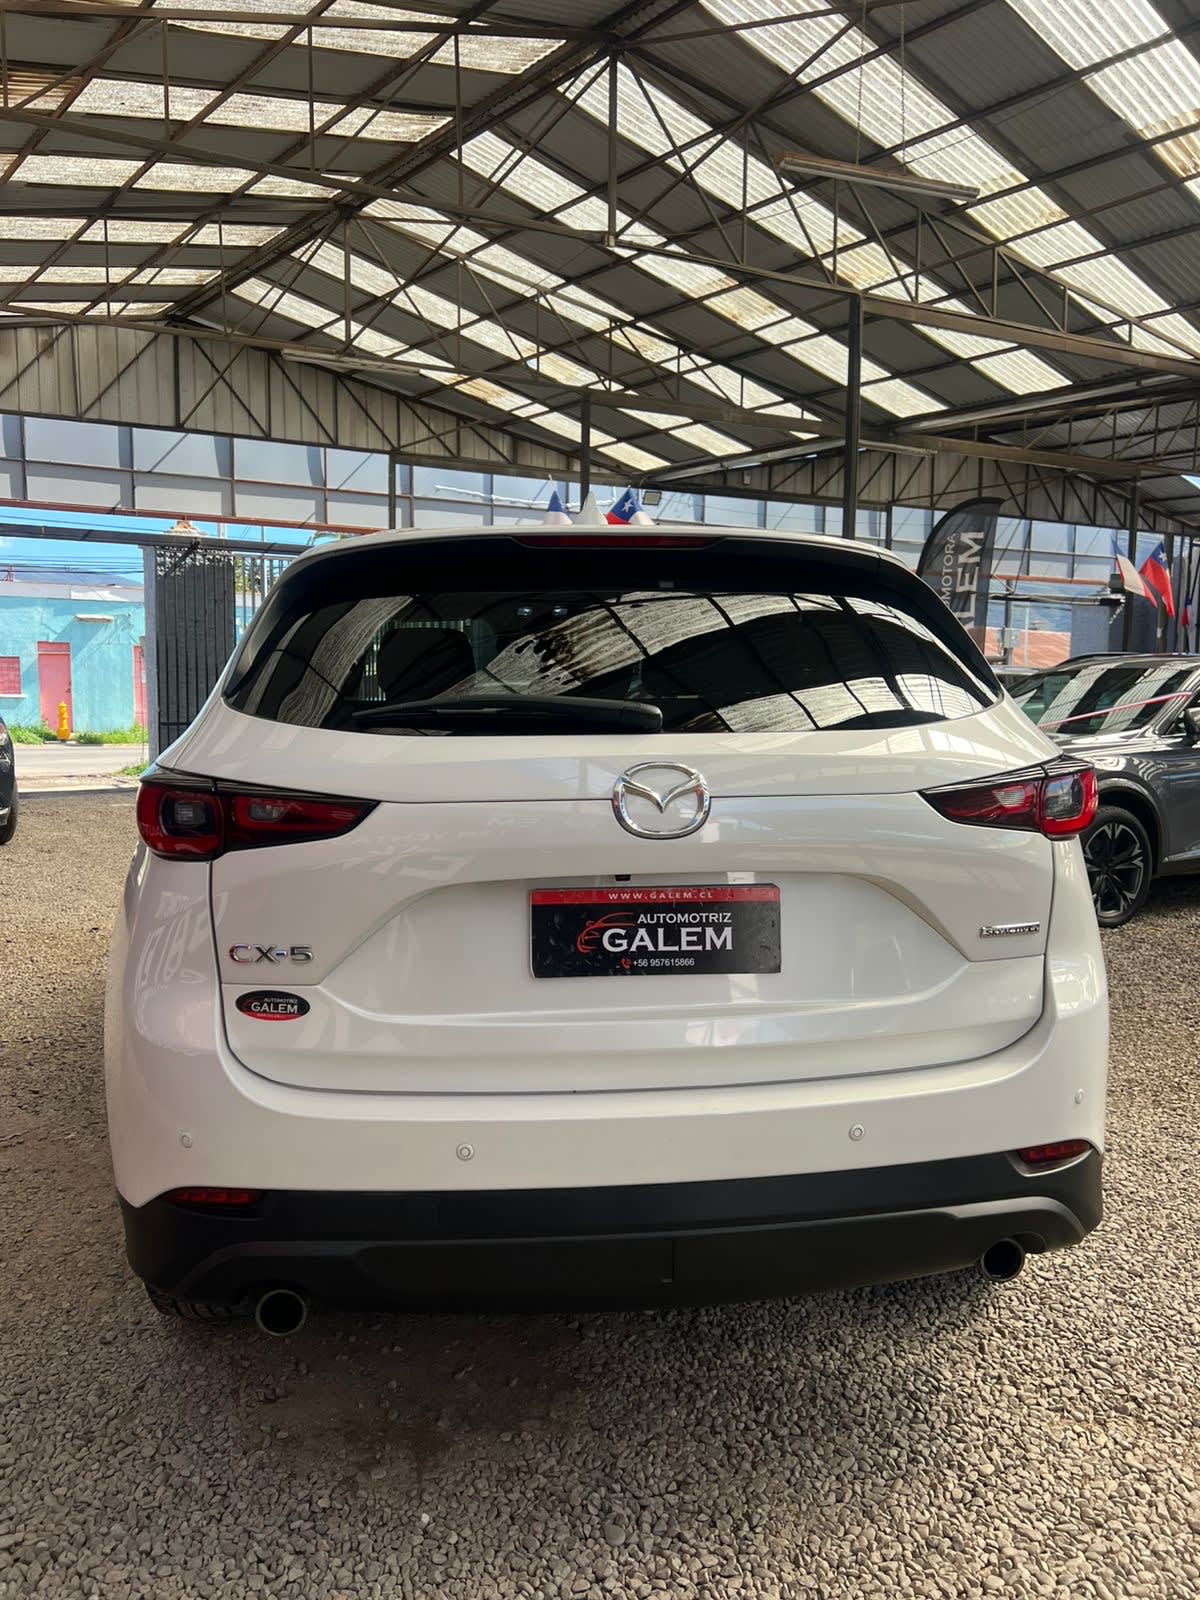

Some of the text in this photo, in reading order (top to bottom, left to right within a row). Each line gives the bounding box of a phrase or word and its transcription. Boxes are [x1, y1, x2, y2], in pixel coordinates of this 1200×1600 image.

[941, 533, 957, 606] MOTORA
[607, 891, 714, 900] WWW.GALEM.CL
[636, 912, 733, 924] AUTOMOTRIZ
[602, 926, 734, 953] GALEM
[229, 943, 313, 964] CX-5
[633, 957, 696, 968] +56 957615866
[251, 1002, 298, 1014] GALEM
